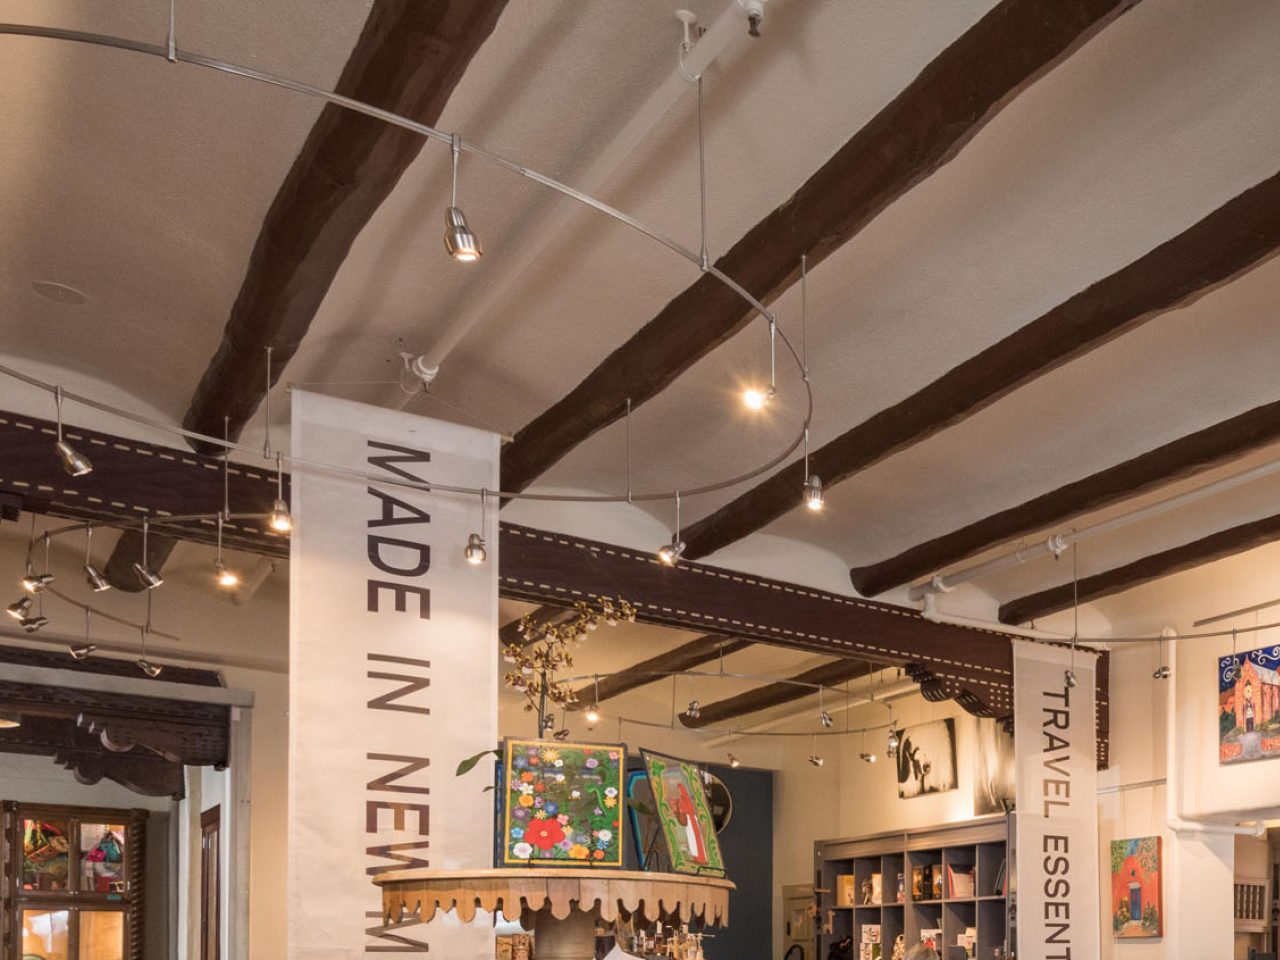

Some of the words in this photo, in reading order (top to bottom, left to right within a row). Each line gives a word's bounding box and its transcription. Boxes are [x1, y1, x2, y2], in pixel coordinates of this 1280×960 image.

[367, 439, 431, 620] MADE
[366, 652, 431, 716] IN
[1042, 686, 1071, 819] TRAVEL
